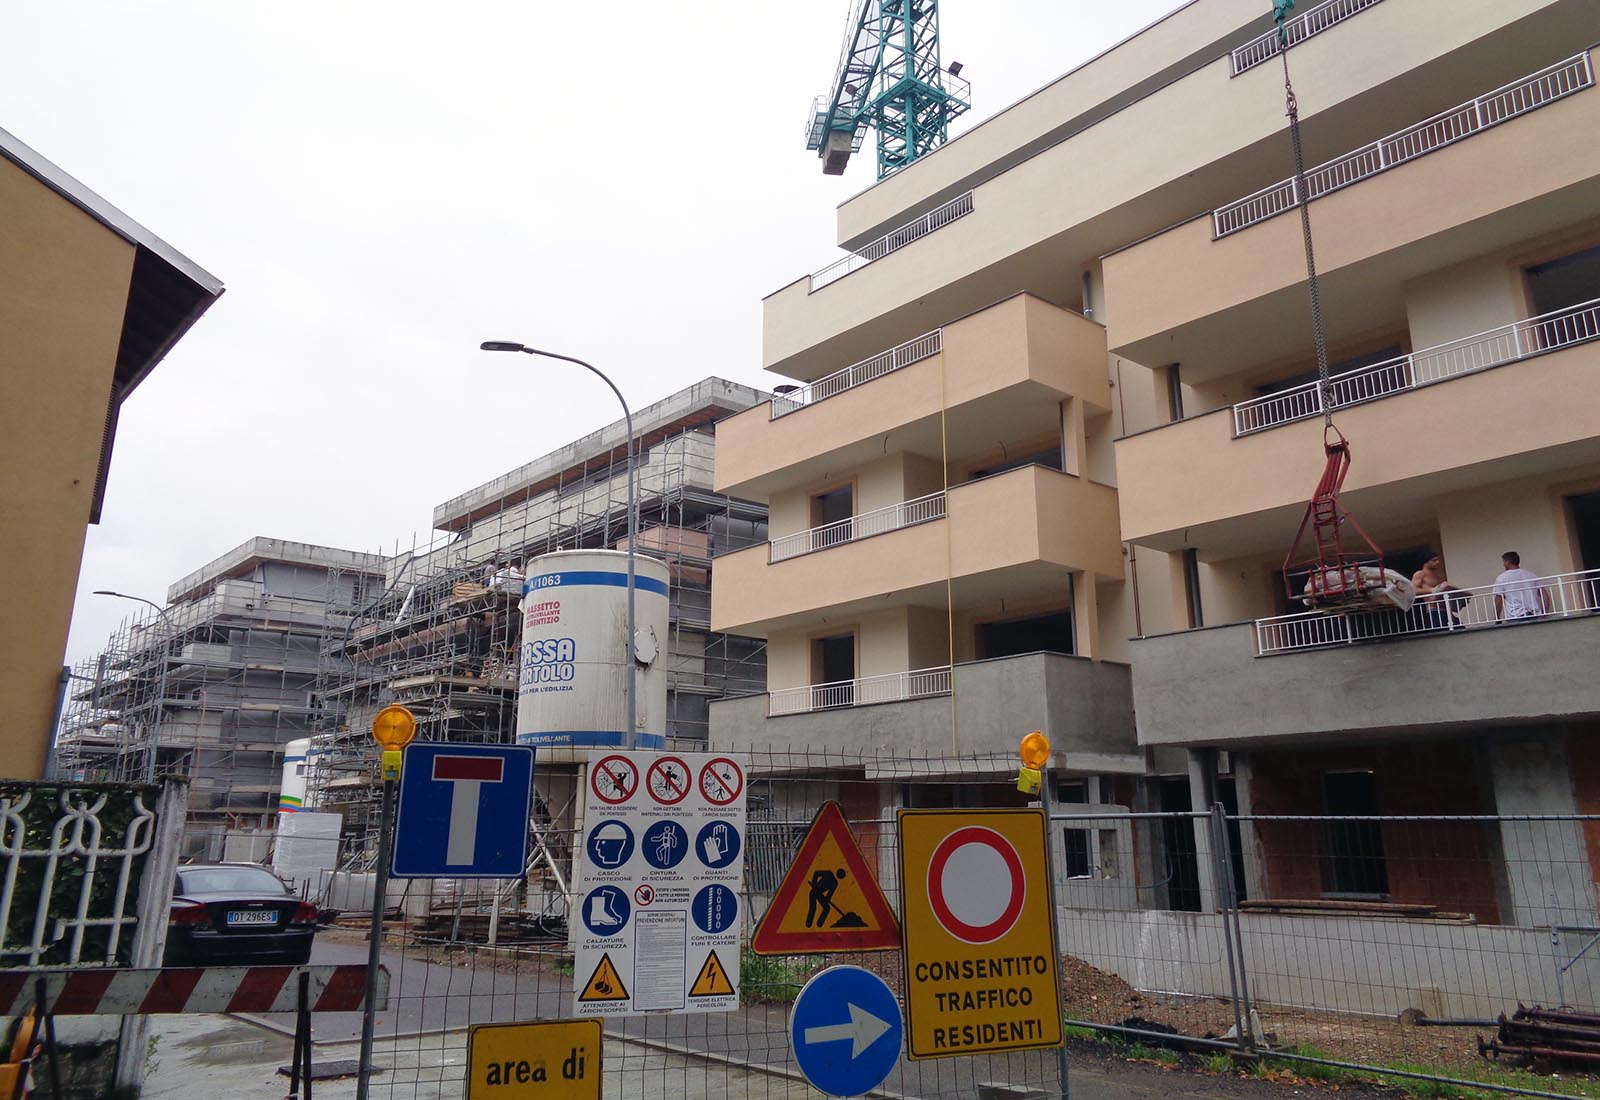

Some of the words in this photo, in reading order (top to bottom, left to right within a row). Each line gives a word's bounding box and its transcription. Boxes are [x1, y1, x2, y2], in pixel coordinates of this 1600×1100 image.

[520, 663, 575, 686] ORTOLO
[540, 685, 573, 693] L'EDILIZIA
[247, 912, 271, 921] 296ES
[915, 955, 1047, 982] CONSENTITO
[935, 987, 1032, 1012] TRAFFICO
[933, 1020, 1042, 1048] RESIDENTI
[486, 1060, 547, 1086] area
[562, 1047, 585, 1080] di
